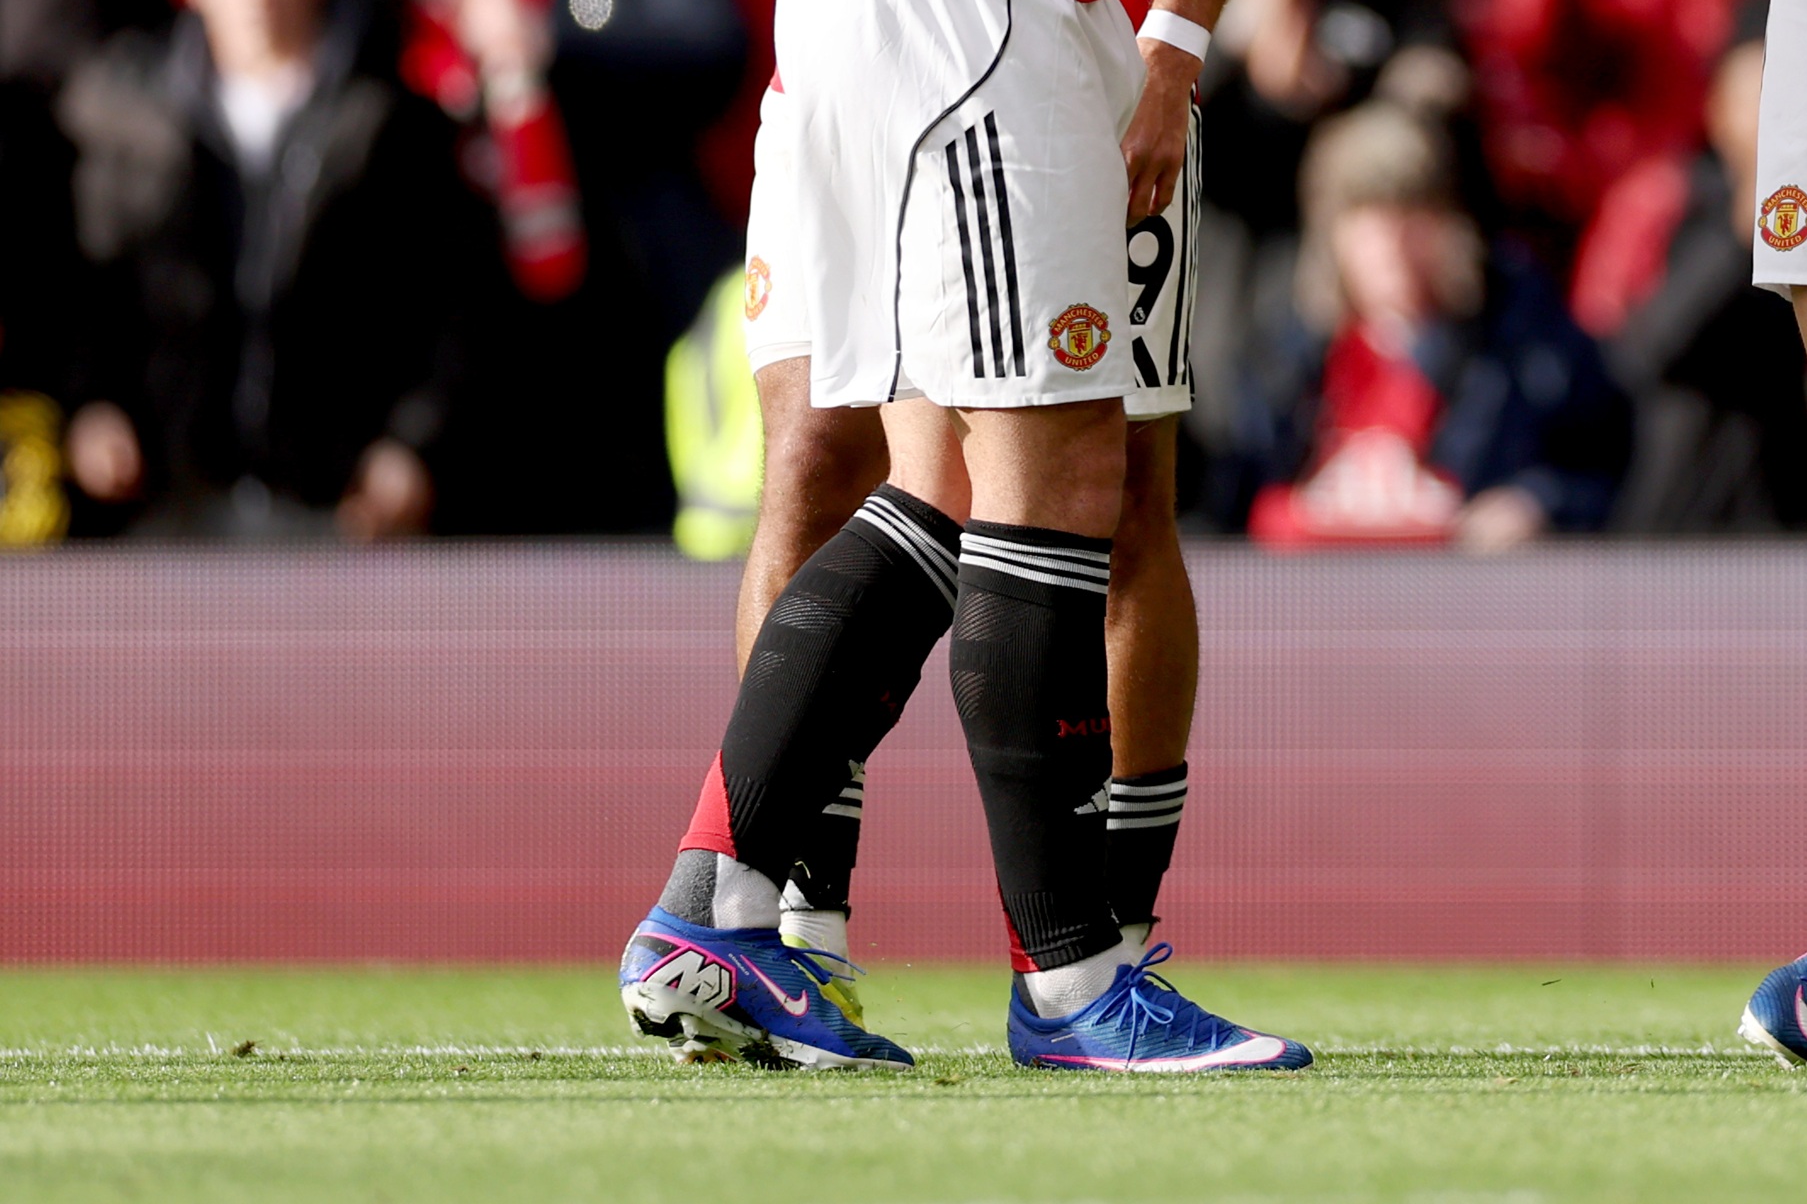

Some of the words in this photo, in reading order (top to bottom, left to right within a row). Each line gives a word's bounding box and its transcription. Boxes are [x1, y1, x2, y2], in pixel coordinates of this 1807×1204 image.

[1768, 235, 1802, 247] UNITED
[1055, 308, 1104, 332] MANCHESTER
[1065, 352, 1099, 366] UNITED
